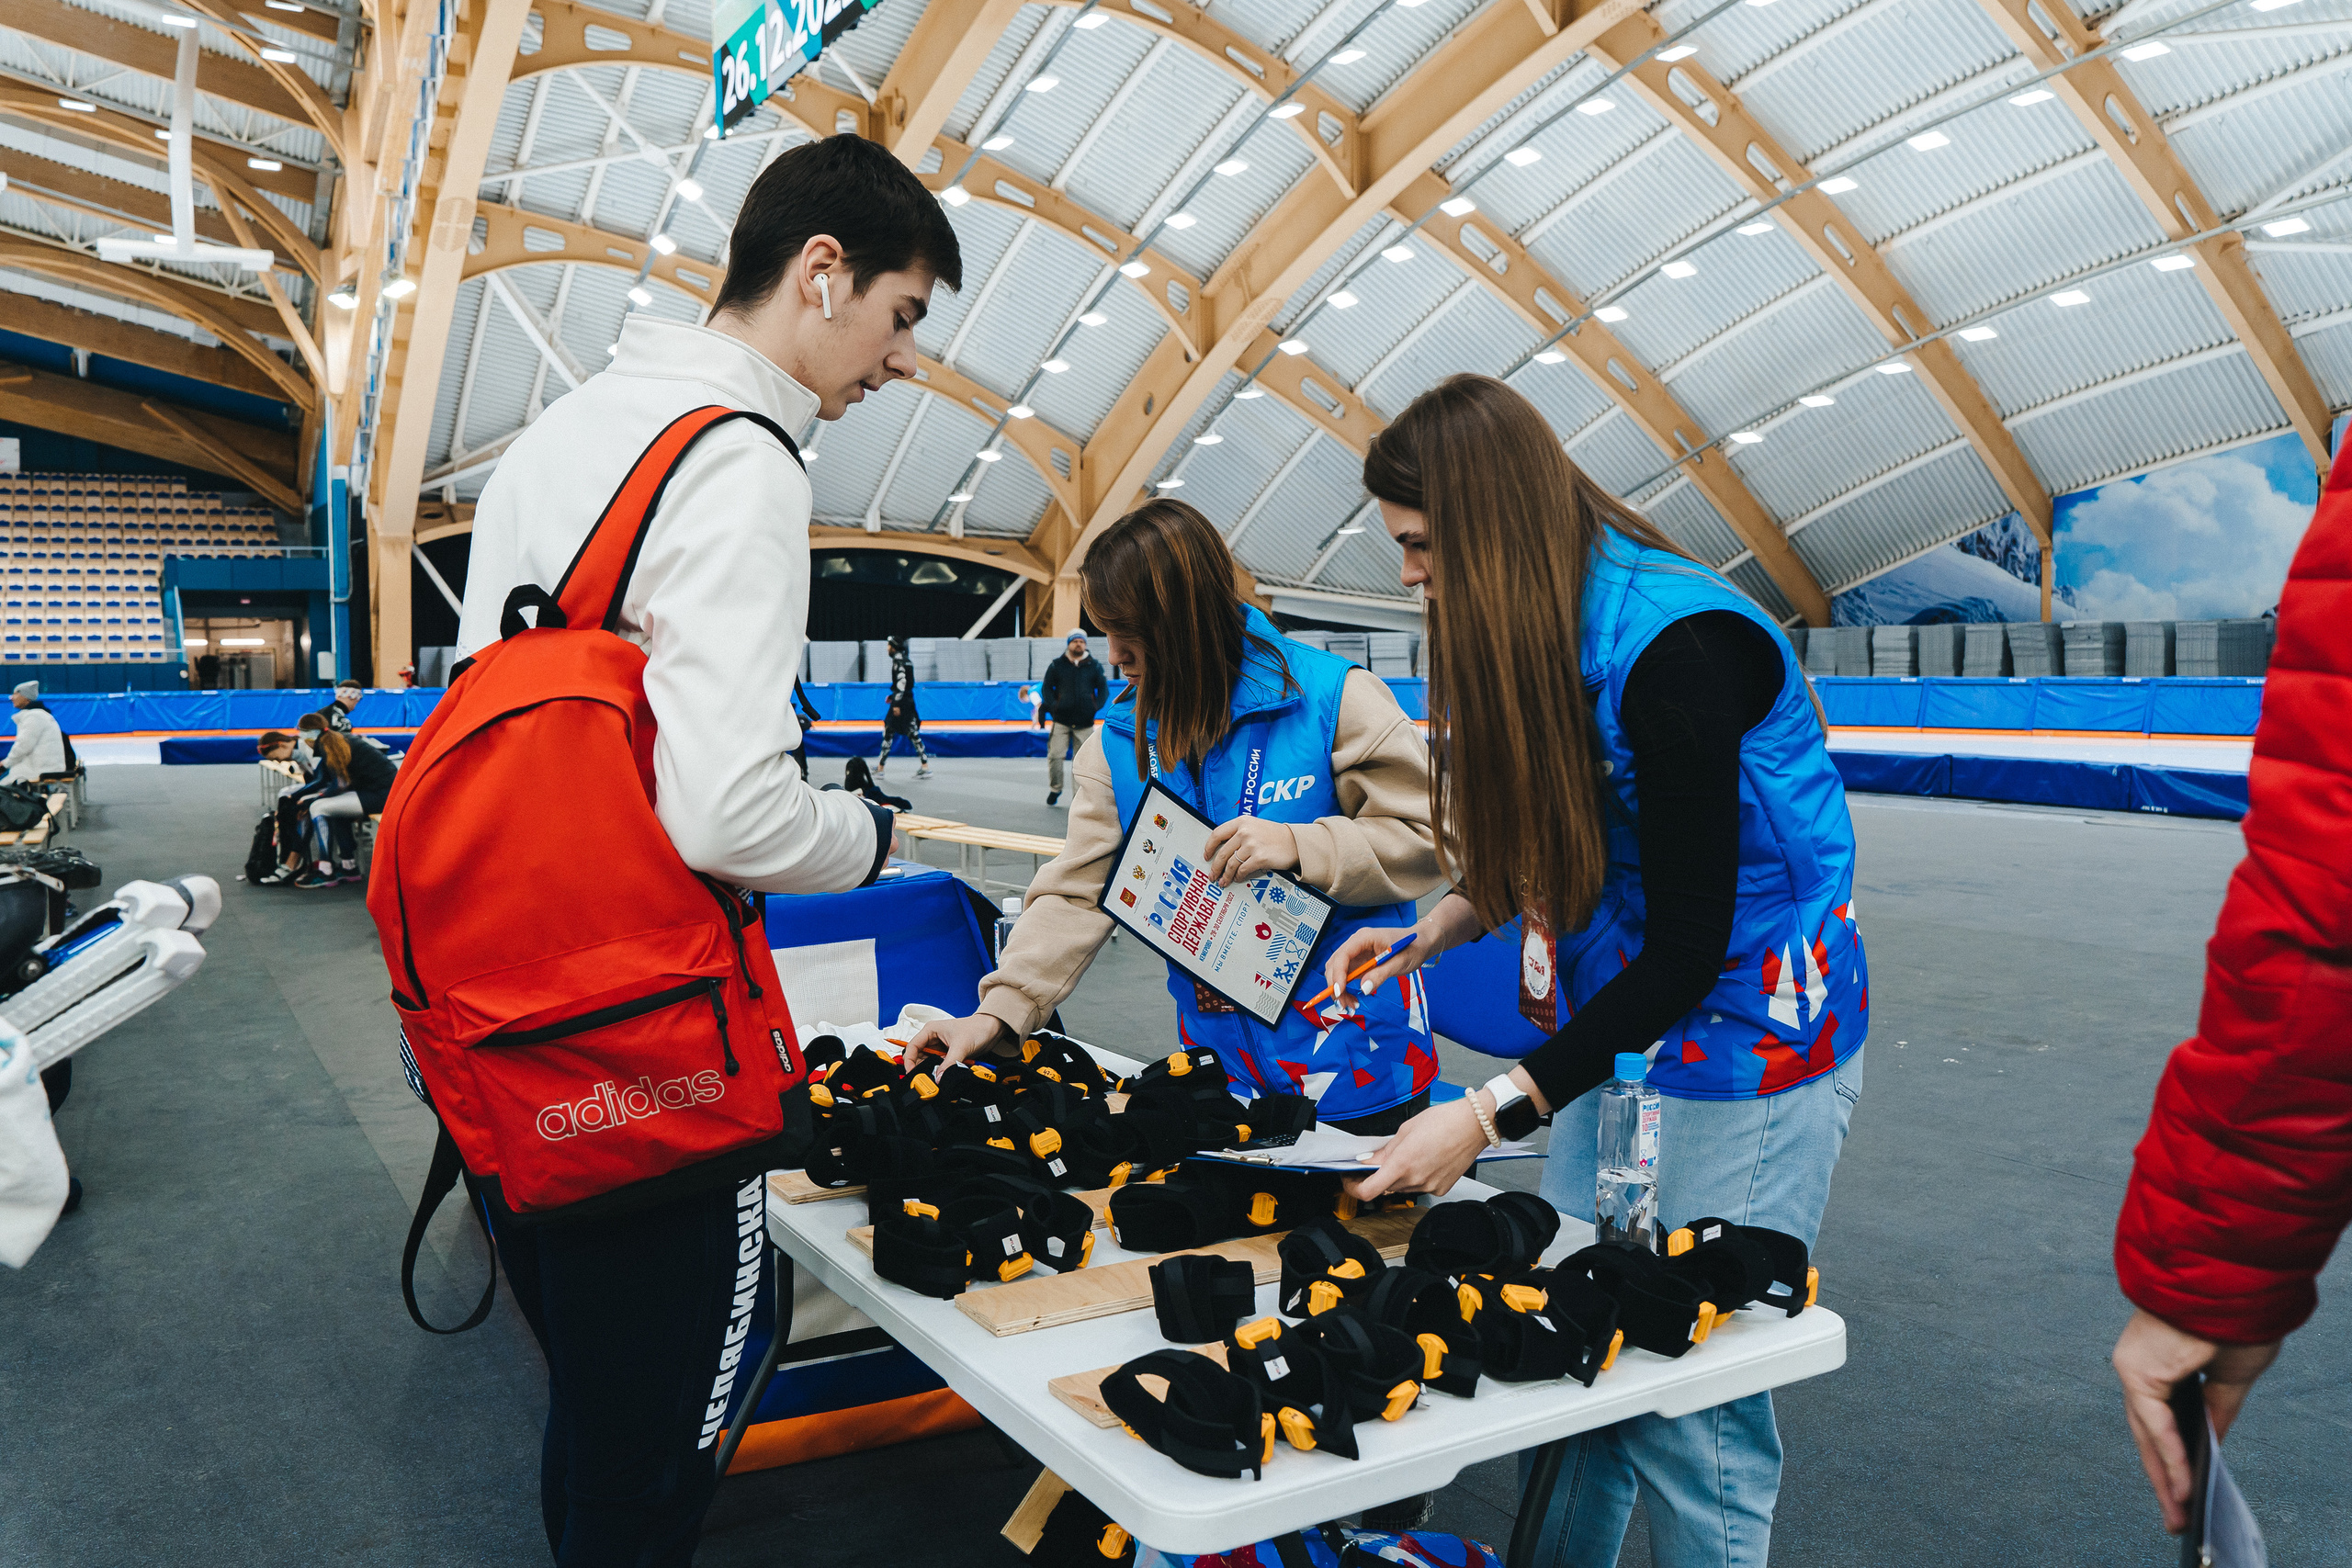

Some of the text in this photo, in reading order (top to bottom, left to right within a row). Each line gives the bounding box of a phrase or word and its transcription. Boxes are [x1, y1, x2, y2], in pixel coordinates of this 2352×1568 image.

[1245, 749, 1261, 795] РОССИИ
[1258, 774, 1316, 805] СКР
[1148, 854, 1194, 934] РОССИЯ
[1168, 869, 1209, 944] СПОРТИВНАЯ
[1182, 883, 1223, 956] ДЕРЖАВА 10
[1199, 939, 1213, 963] КЕМЕРОВО
[1214, 960, 1223, 973] МЫ
[1236, 902, 1250, 927] СПОРТ
[772, 1031, 792, 1073] adidas
[536, 1069, 725, 1141] adidas
[697, 1174, 764, 1450] ЧЕЛЯБИНСКА
